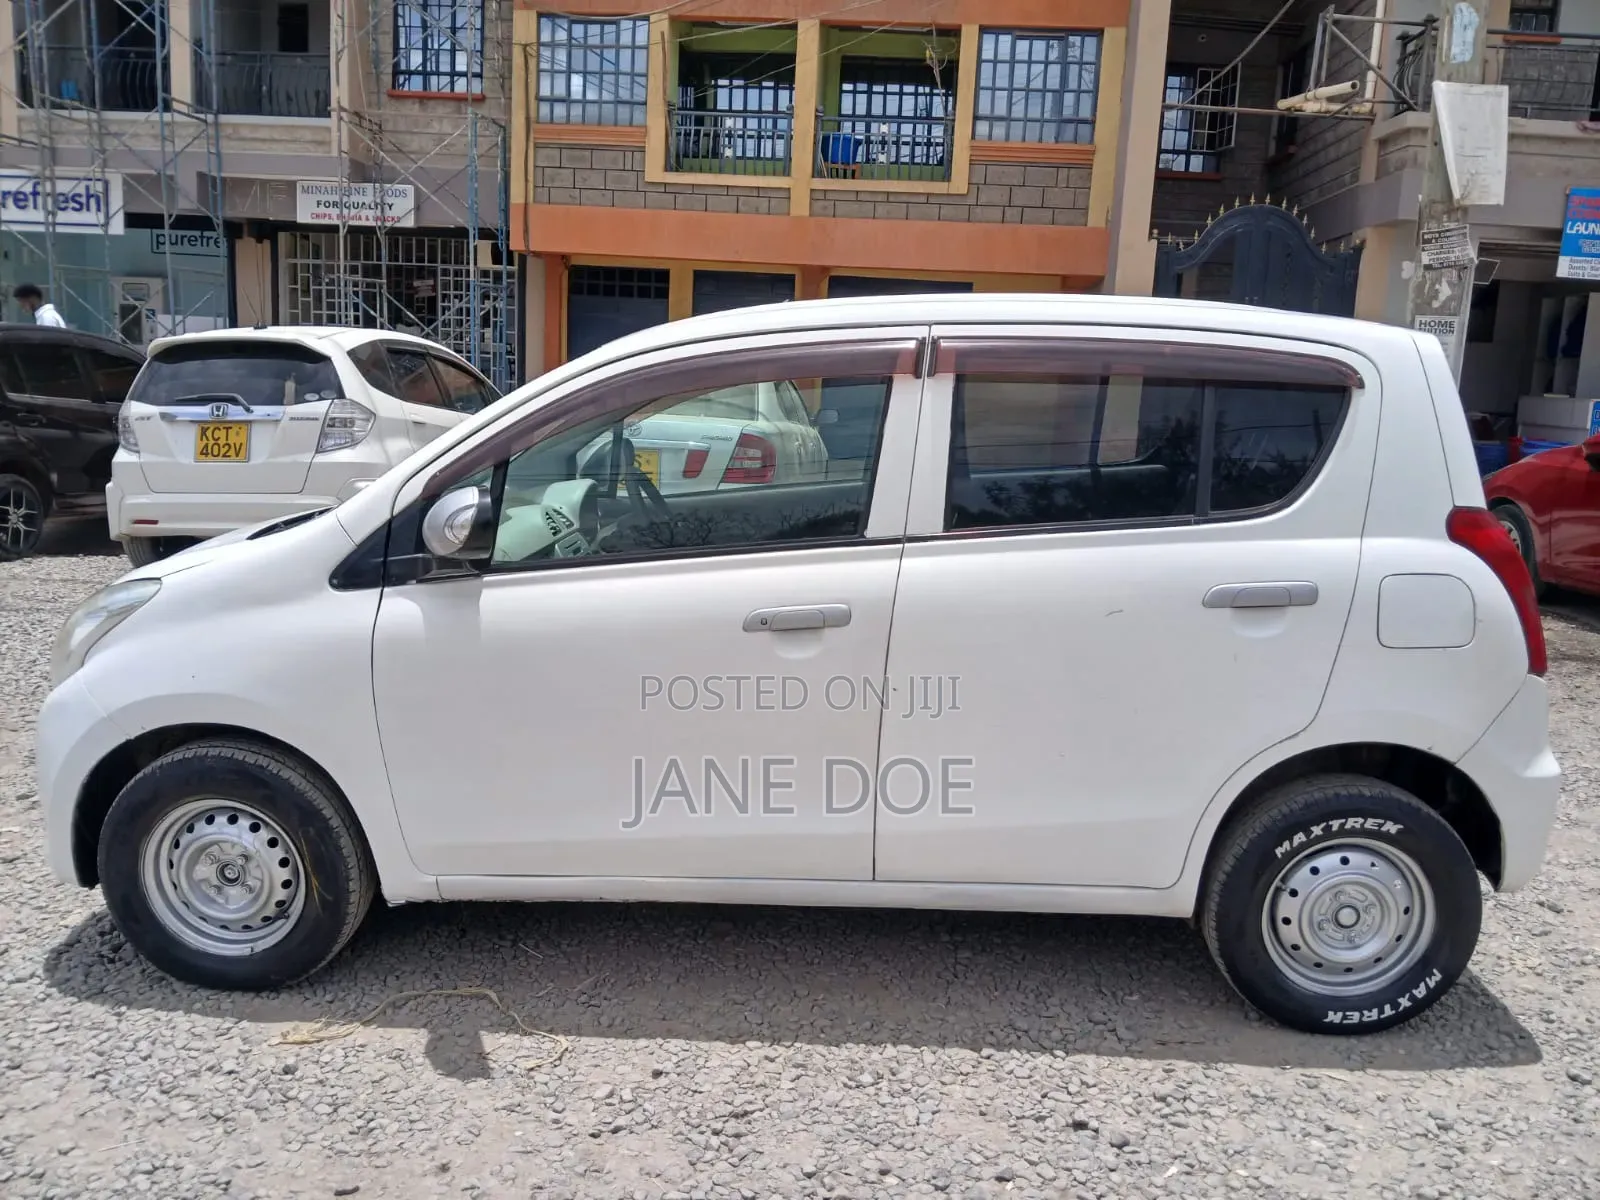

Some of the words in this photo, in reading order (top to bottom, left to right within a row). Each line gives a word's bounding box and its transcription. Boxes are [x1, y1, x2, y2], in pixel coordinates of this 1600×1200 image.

[301, 185, 338, 196] MINAH
[316, 200, 340, 209] FOR
[365, 214, 370, 222] &
[1566, 221, 1600, 235] LAUN
[1418, 319, 1455, 329] HOME
[200, 426, 231, 442] KCT
[199, 442, 243, 458] 402V
[1274, 816, 1406, 859] MAXTREK
[1323, 967, 1443, 1024] MAXTREK
